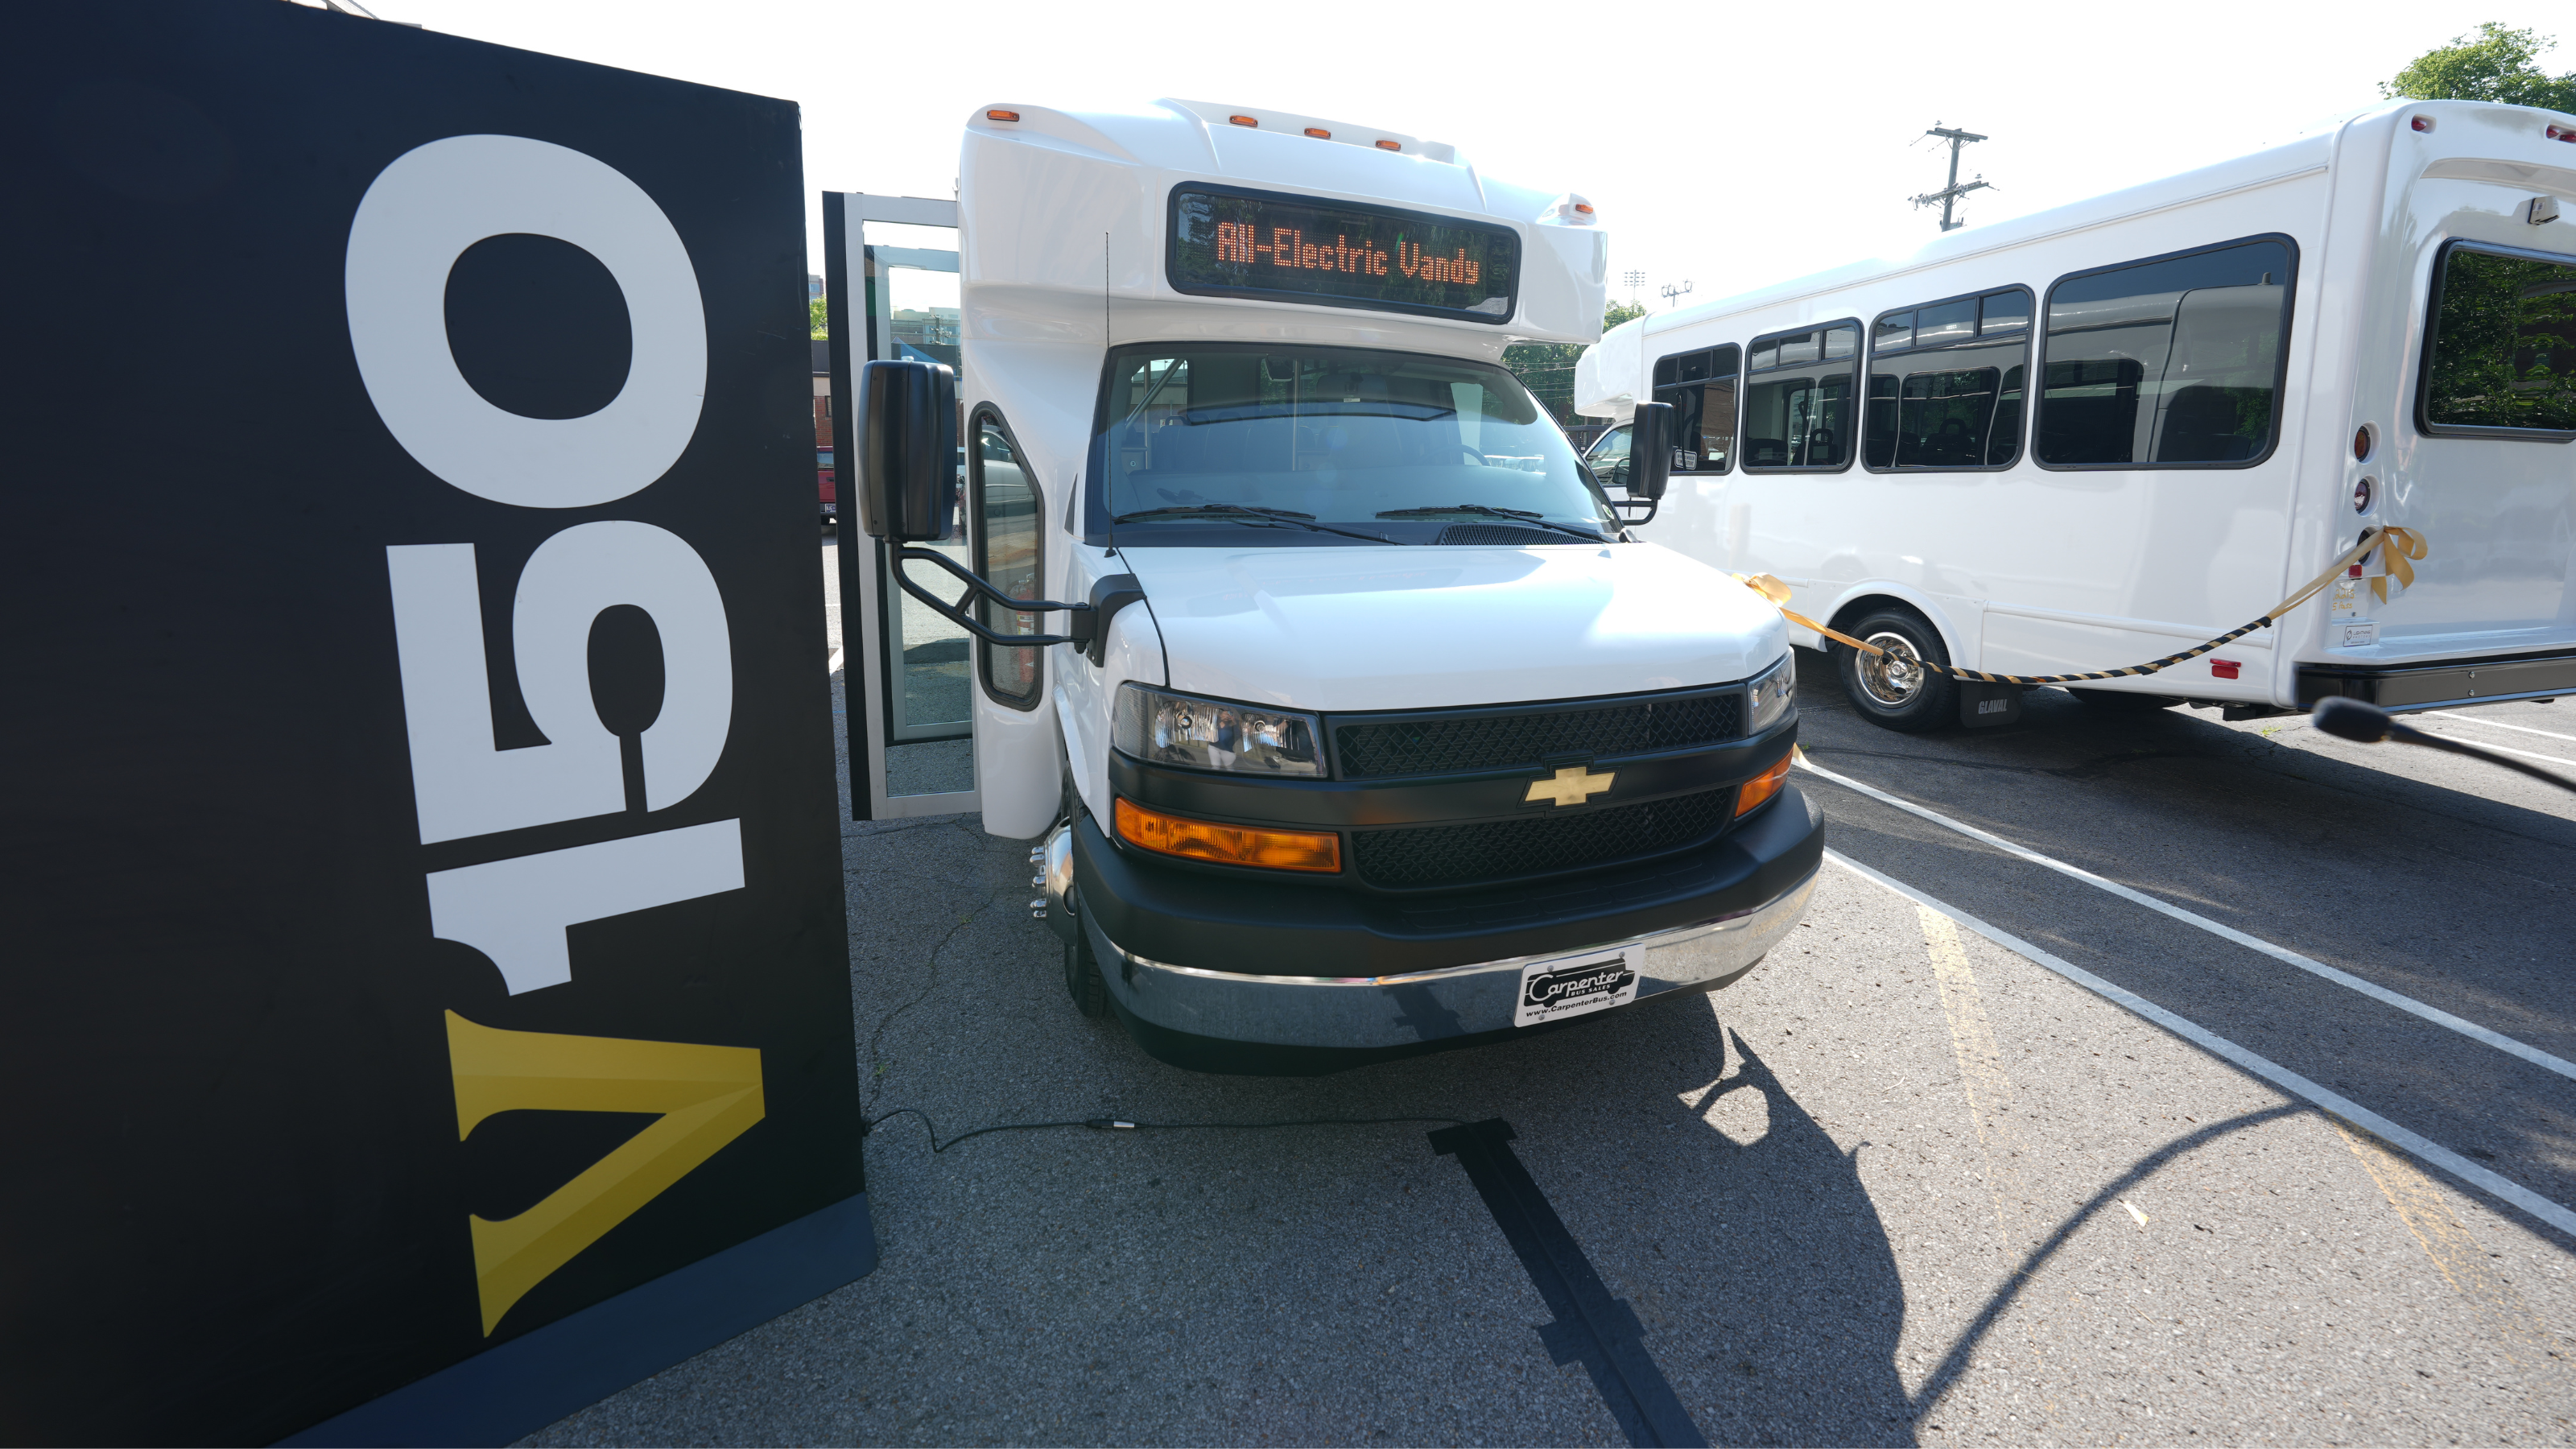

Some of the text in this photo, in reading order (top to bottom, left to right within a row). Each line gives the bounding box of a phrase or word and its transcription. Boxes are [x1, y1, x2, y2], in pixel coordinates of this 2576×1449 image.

[1218, 221, 1479, 284] All-Electric Vandy
[1978, 699, 2008, 714] GLAVAL
[345, 134, 766, 1337] V150
[1530, 971, 1624, 1002] Carpenter
[1588, 984, 1611, 993] SALES
[1525, 992, 1627, 1017] www.CarpenterBus.com
